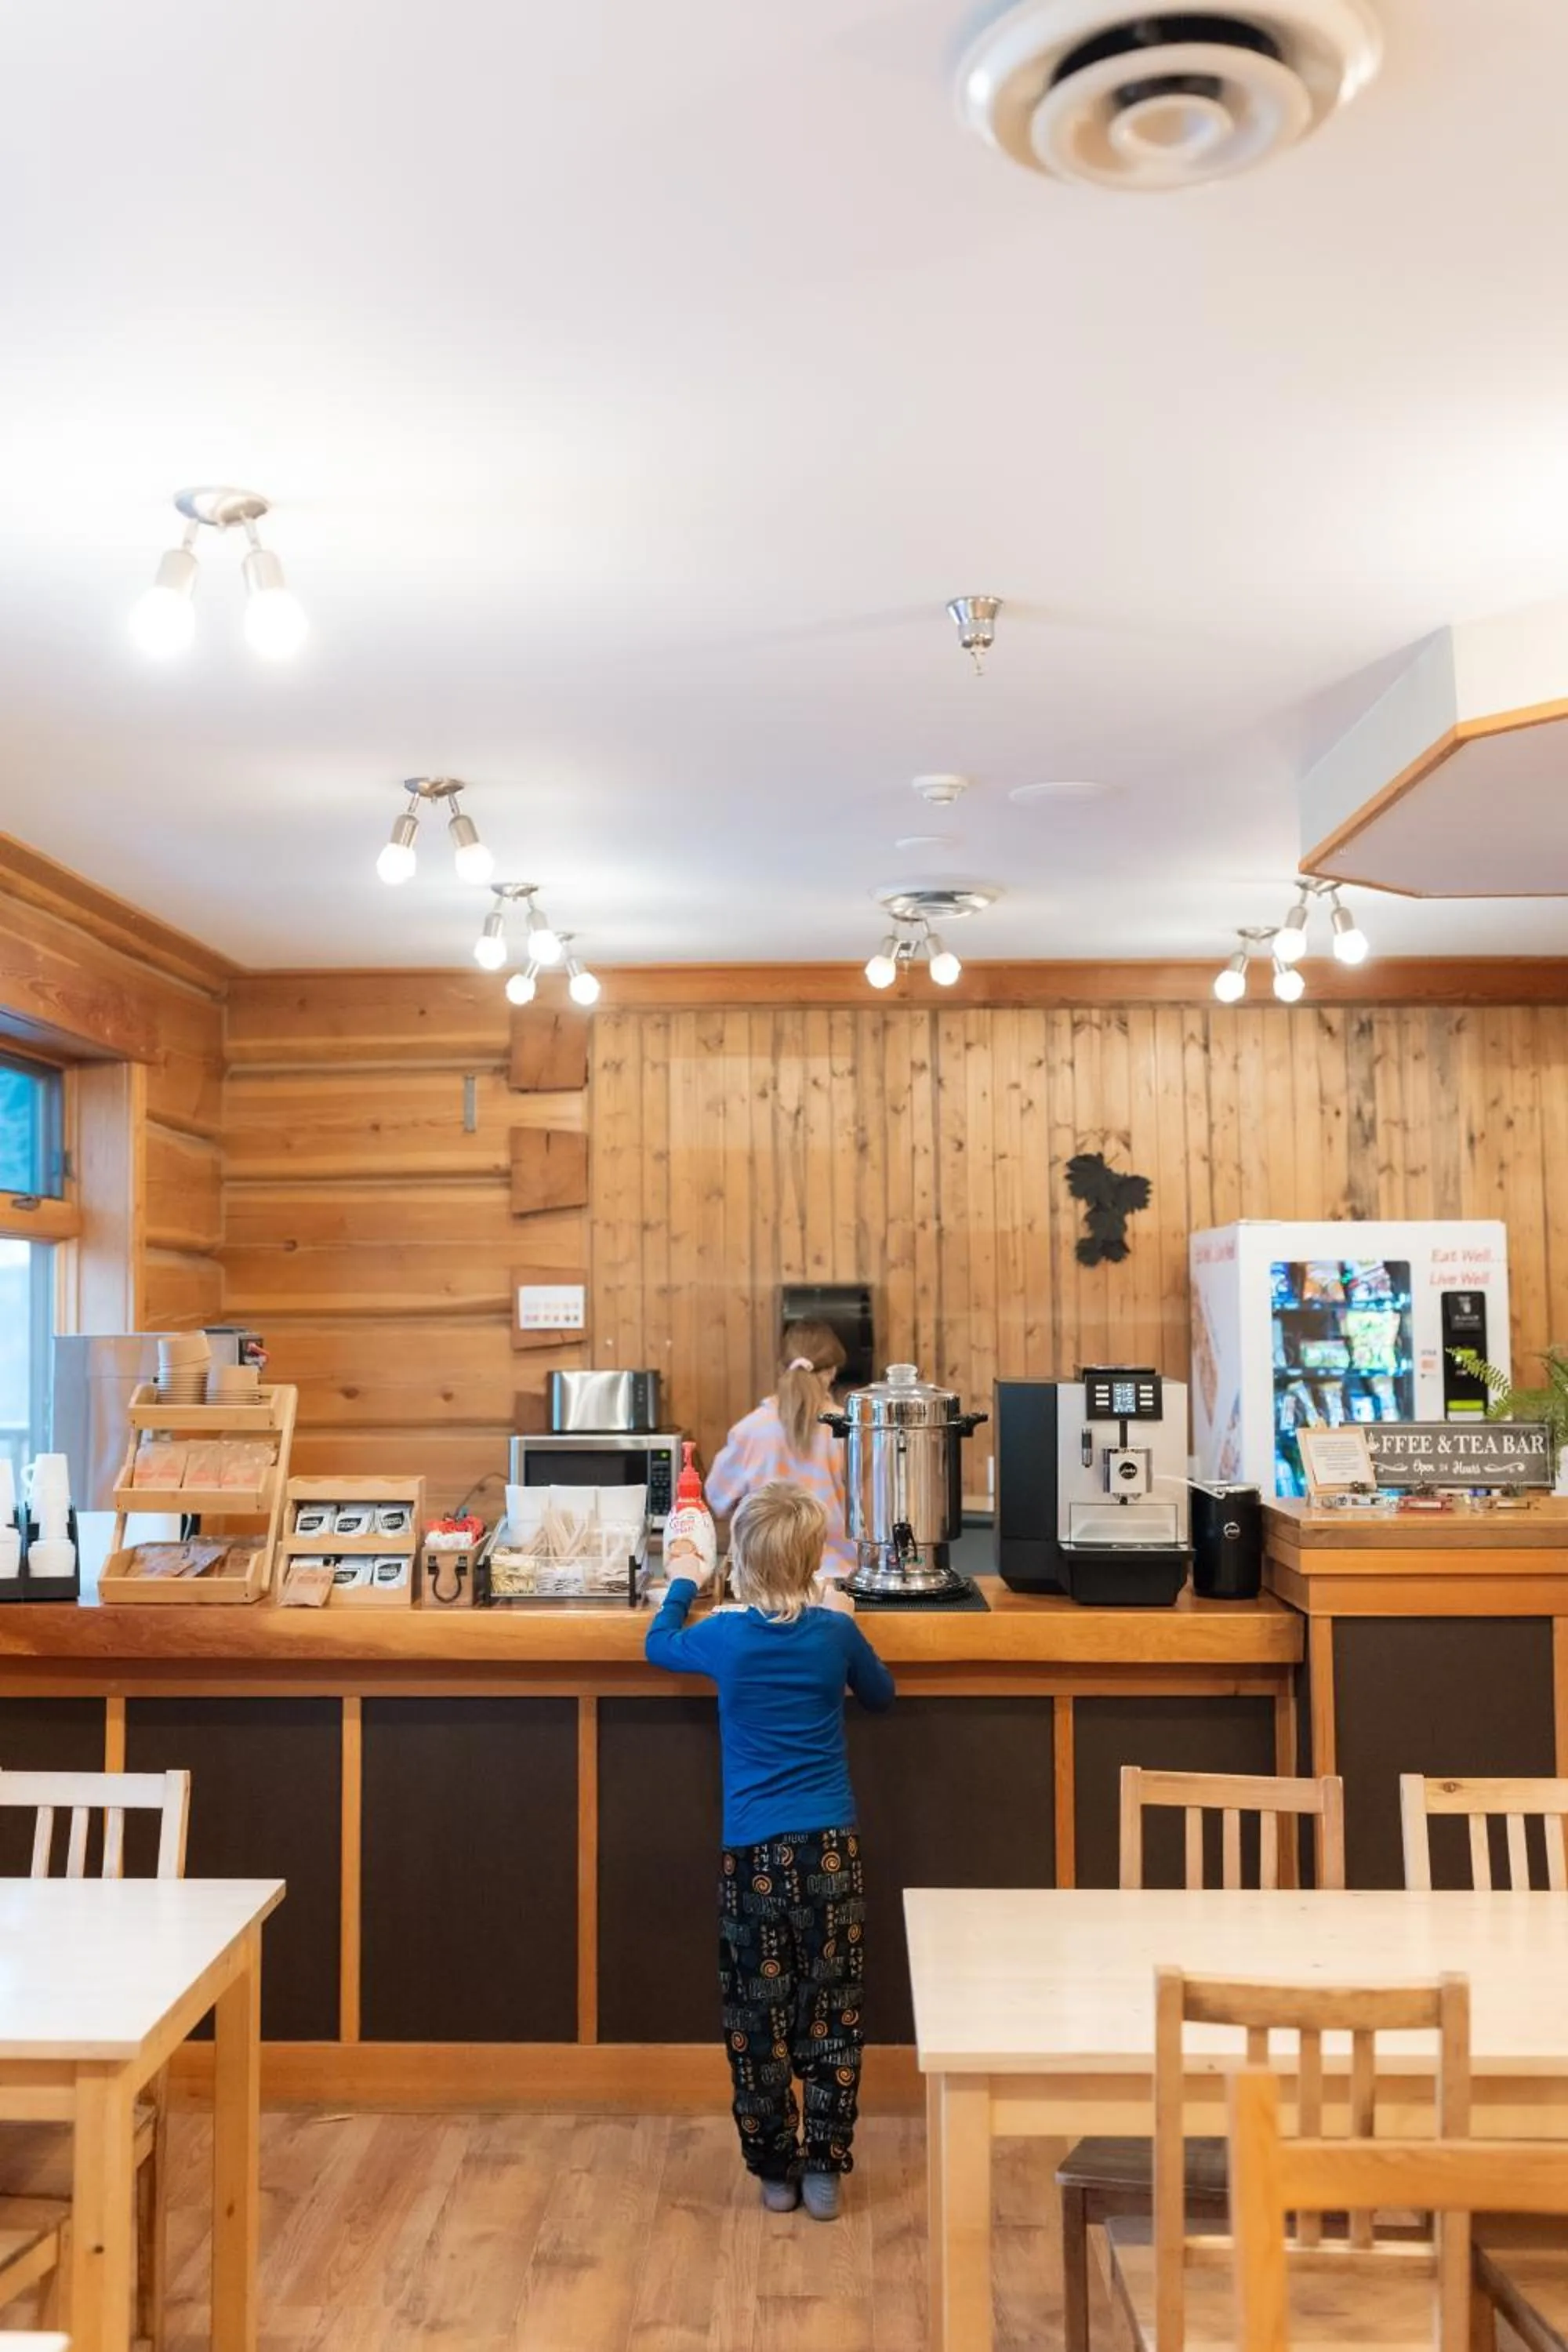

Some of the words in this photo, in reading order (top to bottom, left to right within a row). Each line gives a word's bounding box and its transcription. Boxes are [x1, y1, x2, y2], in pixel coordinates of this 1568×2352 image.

[1431, 1249, 1456, 1263] Eat
[1437, 1435, 1452, 1454] &
[1454, 1435, 1498, 1454] TEA
[1502, 1435, 1544, 1454] BAR
